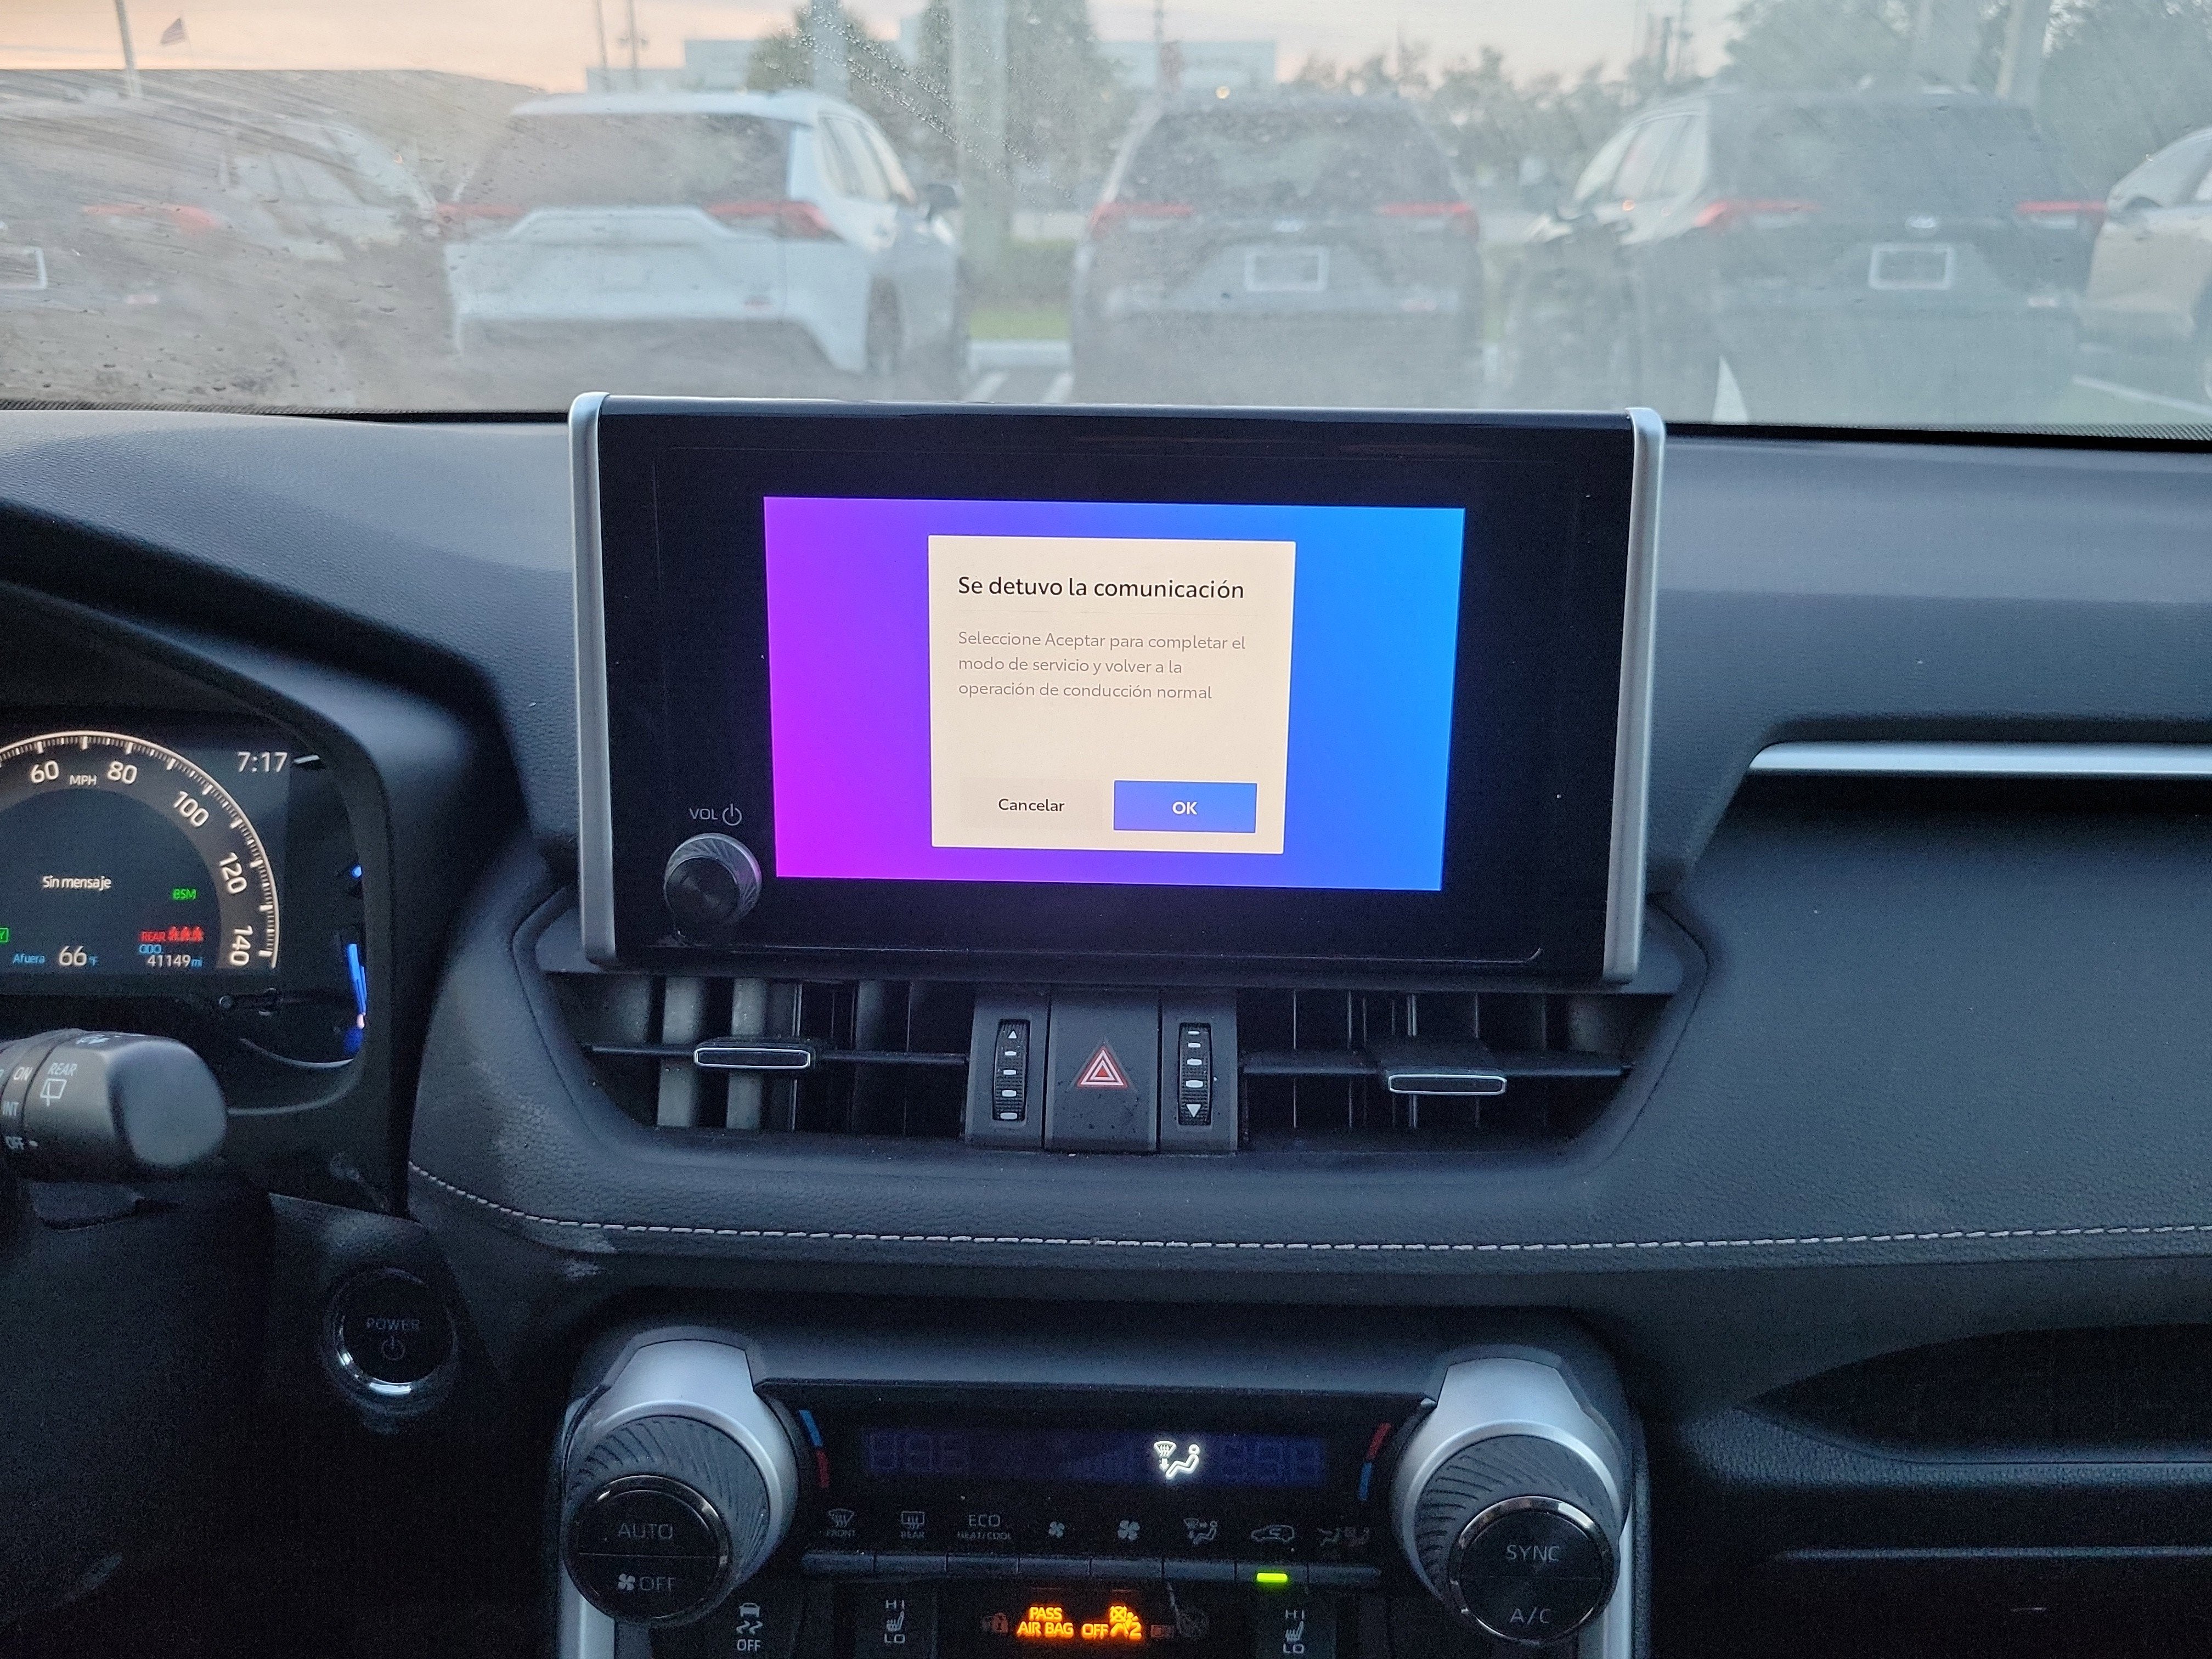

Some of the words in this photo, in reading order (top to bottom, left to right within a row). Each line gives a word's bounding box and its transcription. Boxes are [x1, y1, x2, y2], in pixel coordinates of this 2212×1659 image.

[958, 576, 983, 595] Se
[989, 577, 1063, 596] detuvo
[1069, 578, 1087, 596] la
[1094, 579, 1244, 599] comunicación
[958, 631, 1041, 647] Seleccione
[1045, 633, 1105, 651] Aceptar
[1109, 637, 1144, 652] para
[1148, 635, 1228, 652] completar
[1232, 636, 1245, 650] el
[958, 657, 1005, 670] modo
[1008, 657, 1028, 671] de
[1032, 658, 1089, 672] servicio
[1092, 662, 1102, 675] y
[1105, 659, 1152, 673] volver
[1155, 664, 1164, 674] a
[1168, 660, 1182, 674] la
[958, 682, 1035, 698] operación
[1039, 682, 1059, 696] de
[1063, 684, 1152, 698] conducción
[1156, 685, 1212, 699] normal
[237, 751, 287, 772] 7:17
[31, 760, 59, 783] 60
[107, 760, 138, 785] 80
[69, 775, 97, 786] MPH
[173, 791, 208, 827] 100
[998, 798, 1065, 812] Cancelar
[1172, 801, 1198, 816] OK
[690, 808, 718, 820] VOL
[219, 852, 247, 894] 120
[42, 876, 60, 888] Sin
[61, 876, 111, 891] mensaje
[173, 888, 196, 900] BSM
[229, 925, 253, 967] 140
[13, 953, 45, 963] Afuera
[14, 1066, 33, 1081] ON
[48, 1063, 78, 1076] REAR
[366, 1318, 420, 1331] POWER
[969, 1514, 1001, 1527] ECO
[618, 1523, 674, 1540] AUTO
[1505, 1545, 1559, 1562] SYNC
[639, 1576, 676, 1593] OFF
[885, 1600, 905, 1610] HI
[1030, 1607, 1062, 1622] PASS
[1285, 1609, 1305, 1619] HI
[1510, 1608, 1551, 1624] A/C
[1017, 1622, 1042, 1637] AIR
[1045, 1622, 1074, 1637] BAG
[1082, 1623, 1109, 1639] OFF
[737, 1640, 761, 1652] OFF
[884, 1634, 905, 1644] LO
[1283, 1644, 1305, 1655] LO
